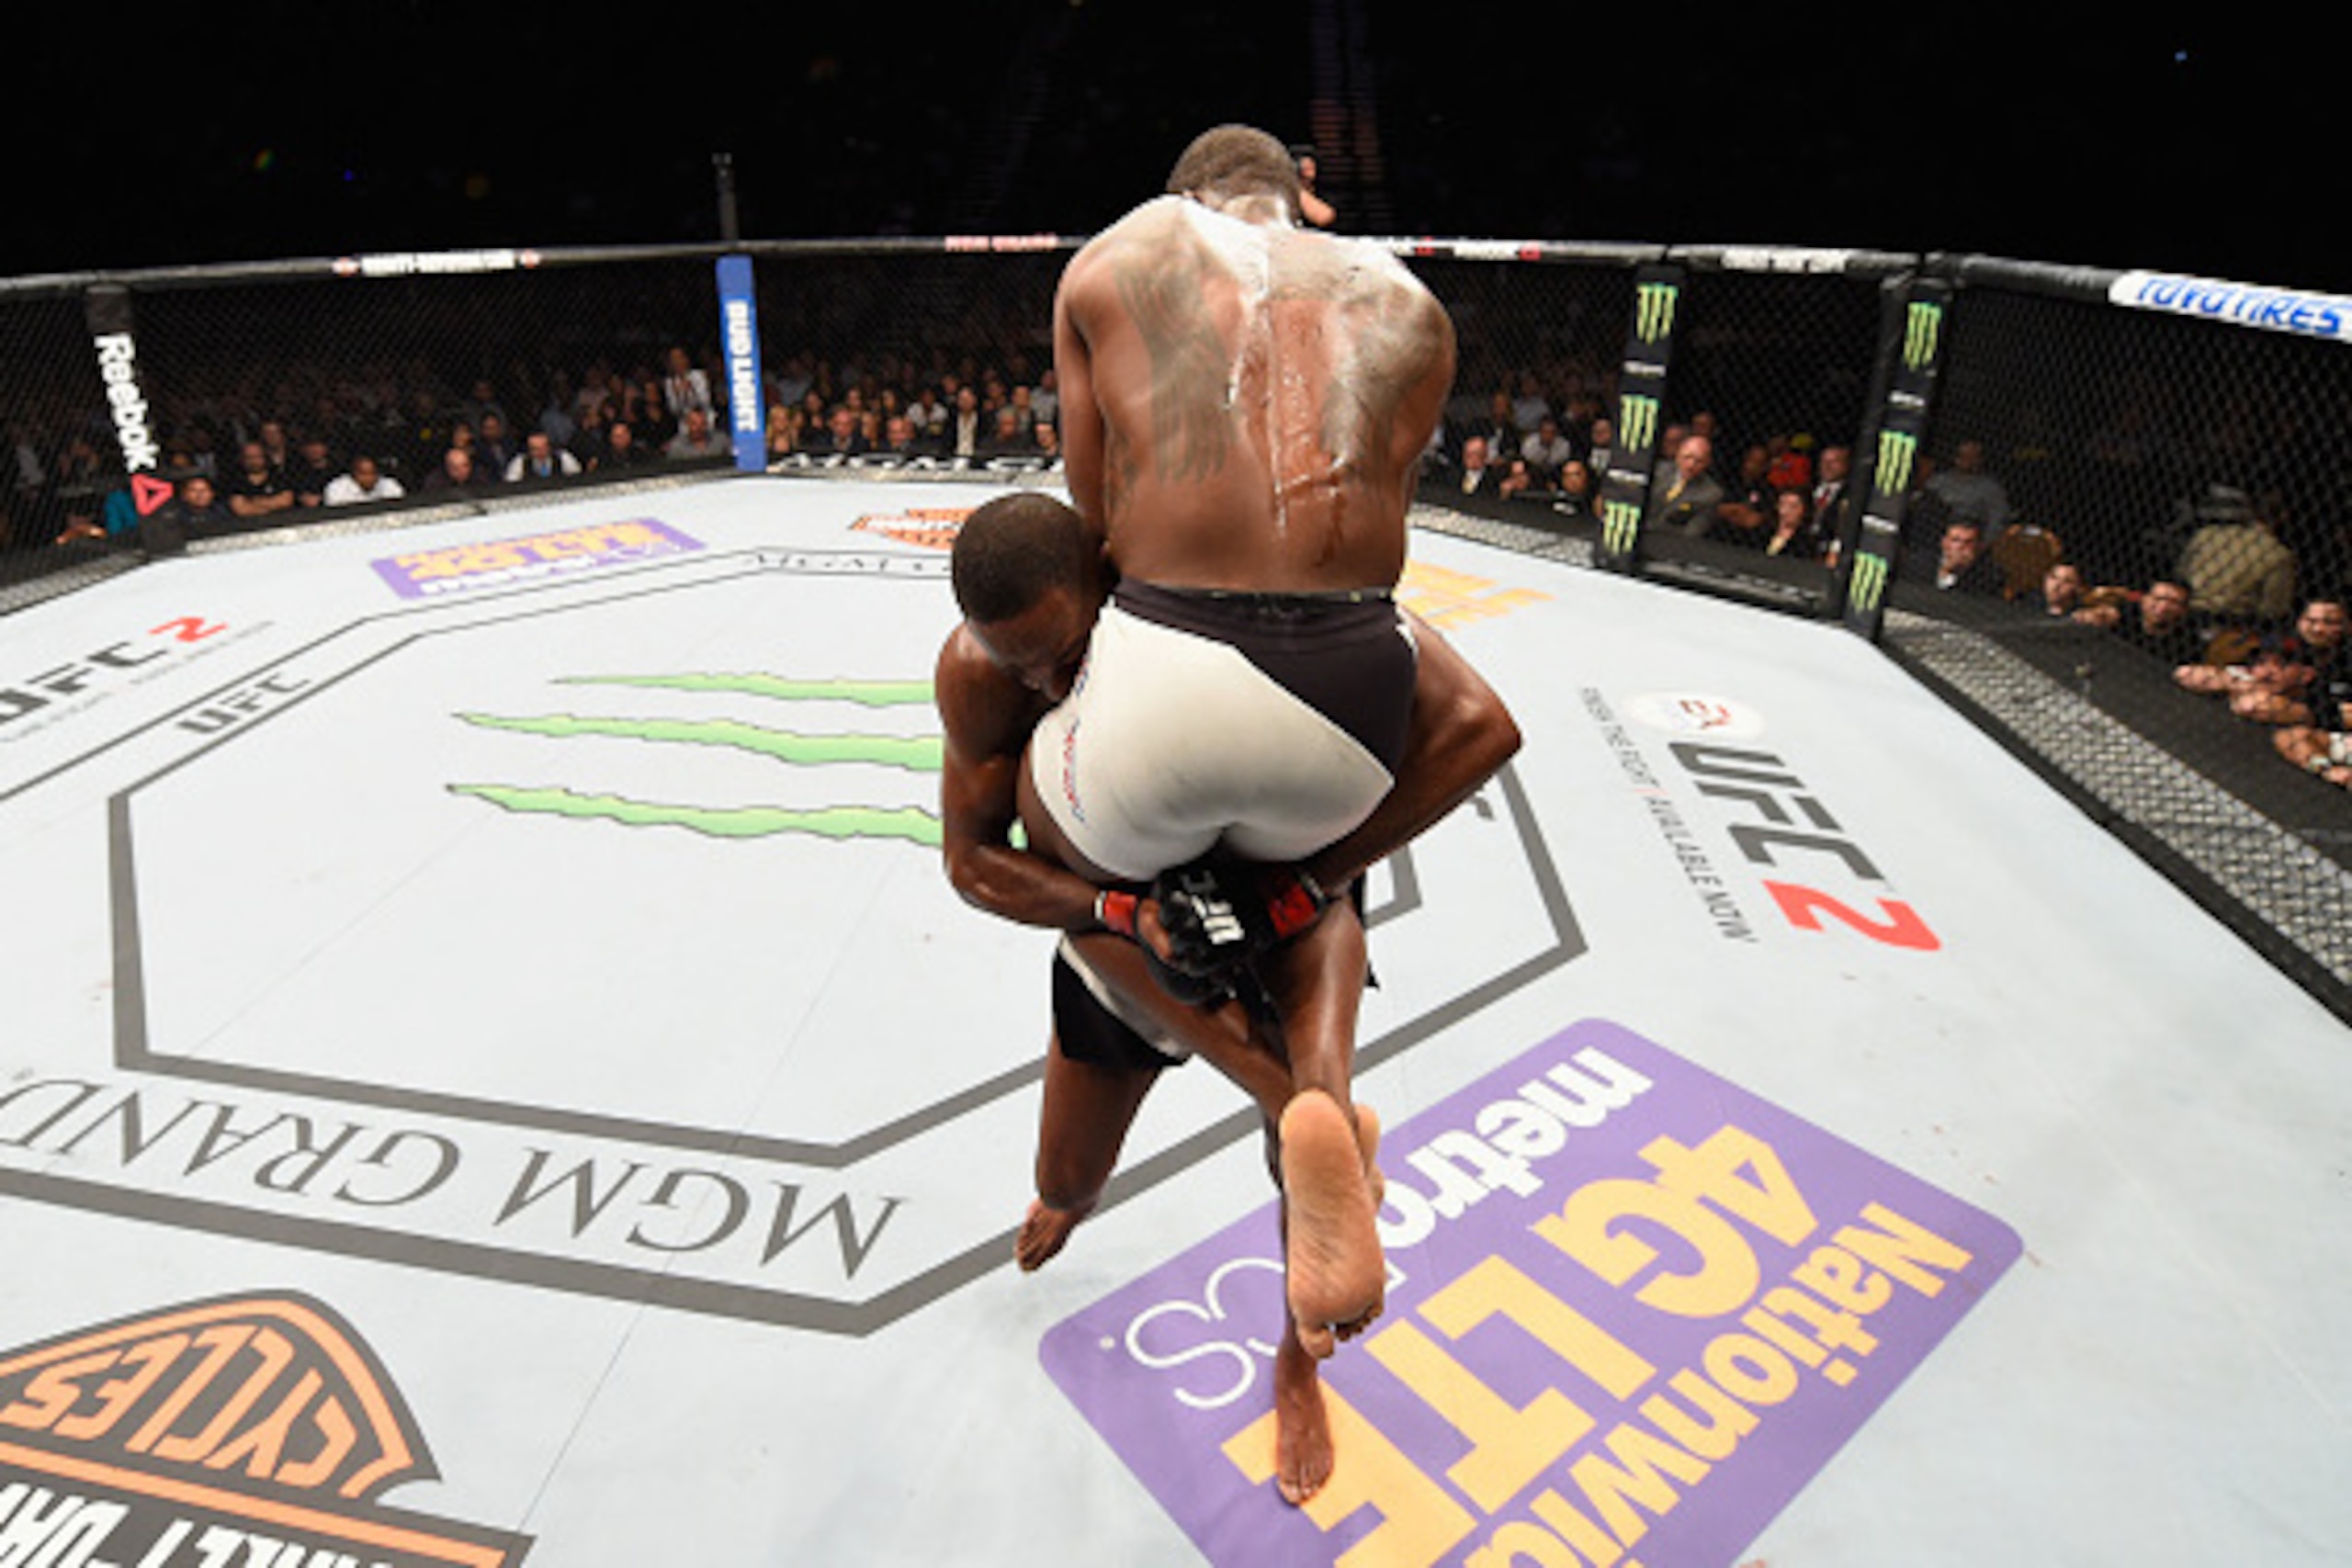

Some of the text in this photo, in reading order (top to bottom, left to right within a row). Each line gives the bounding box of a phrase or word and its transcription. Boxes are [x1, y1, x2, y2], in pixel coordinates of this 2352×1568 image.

[94, 333, 160, 473] Reebok
[731, 356, 759, 433] LIGHT
[147, 616, 229, 642] 2
[175, 672, 311, 734] UFC
[1644, 795, 1722, 885] AVAILABLE
[1698, 889, 1759, 943] NOW
[1668, 741, 1941, 952] UFC 2
[492, 1148, 910, 1280] MGM
[0, 1323, 359, 1488] CYCLES
[1220, 1122, 1820, 1568] 4G LTE
